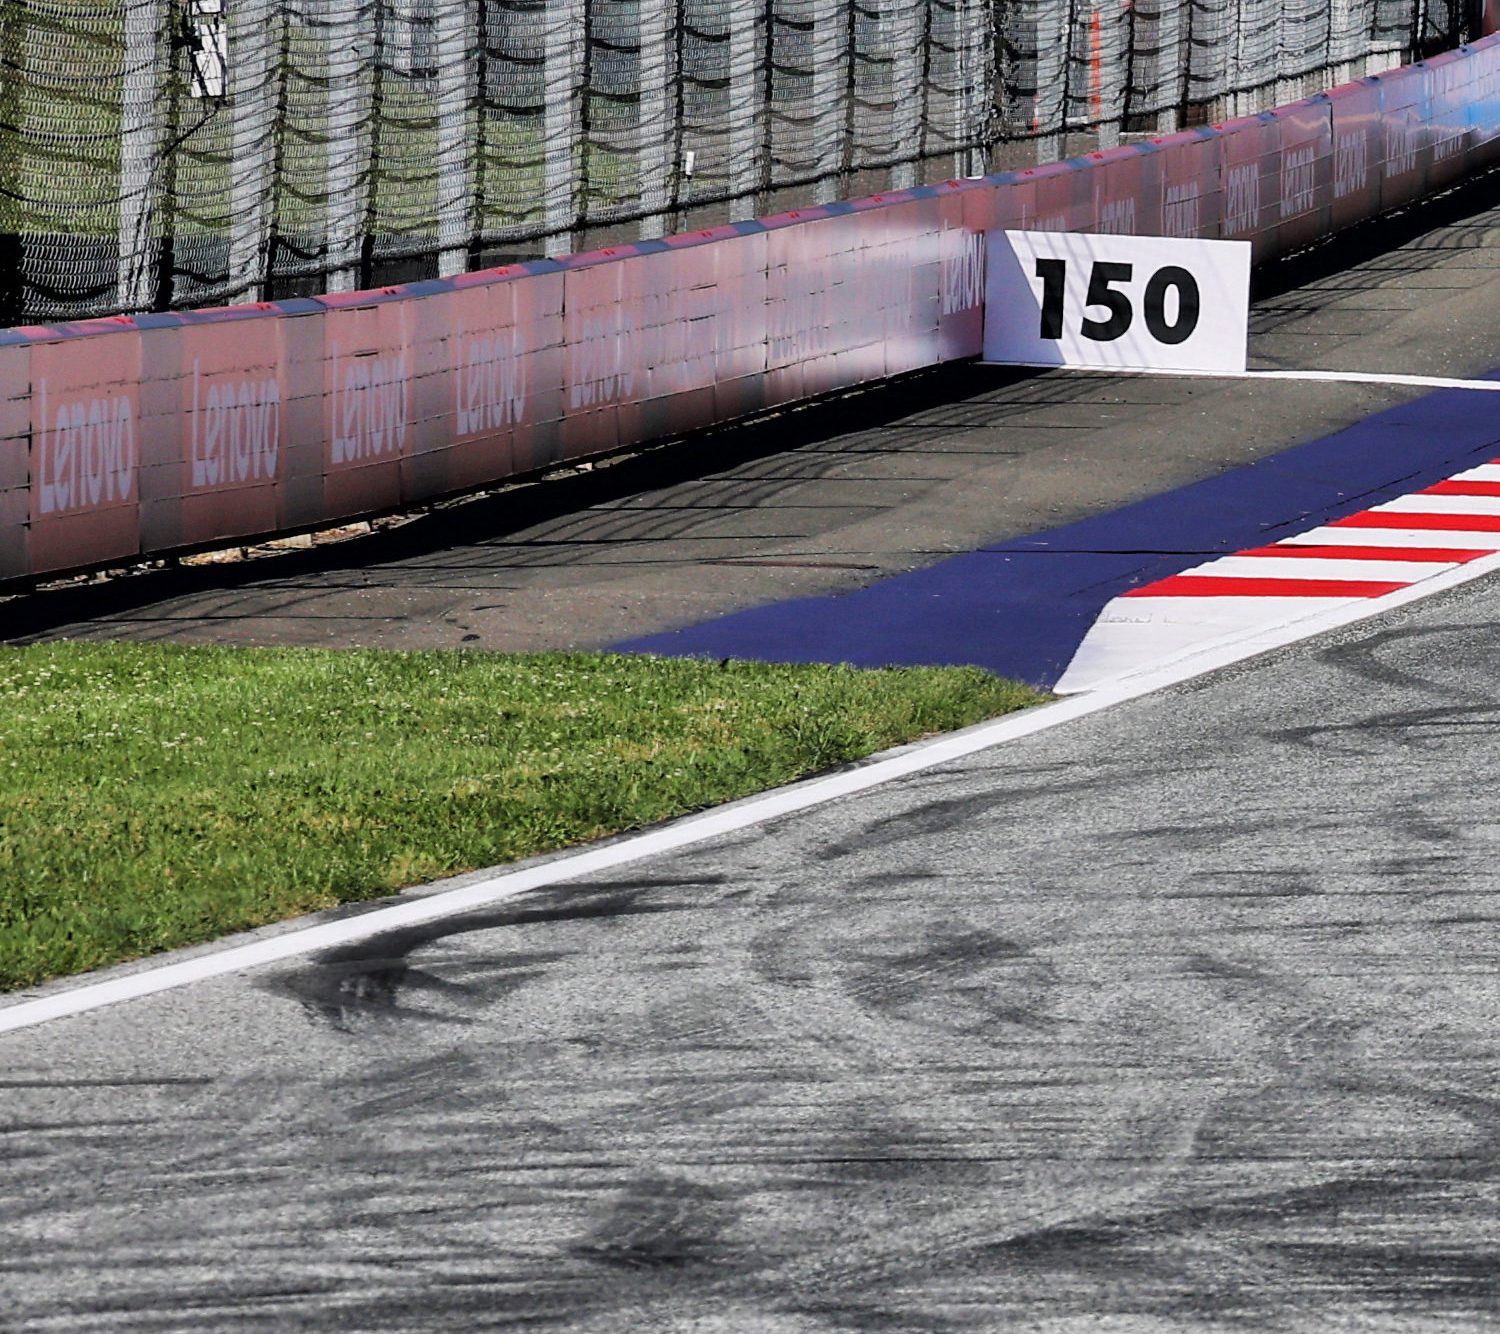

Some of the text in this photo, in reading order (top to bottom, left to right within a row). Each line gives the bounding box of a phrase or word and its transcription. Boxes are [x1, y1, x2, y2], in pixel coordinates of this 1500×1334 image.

[1224, 158, 1260, 236] Lenovo
[1280, 142, 1315, 218] Lenovo
[1034, 257, 1201, 346] 150
[191, 357, 280, 488] Lenovo
[330, 340, 408, 464] Lenovo
[455, 319, 527, 435] Lenovo
[38, 377, 134, 514] Lenovo
